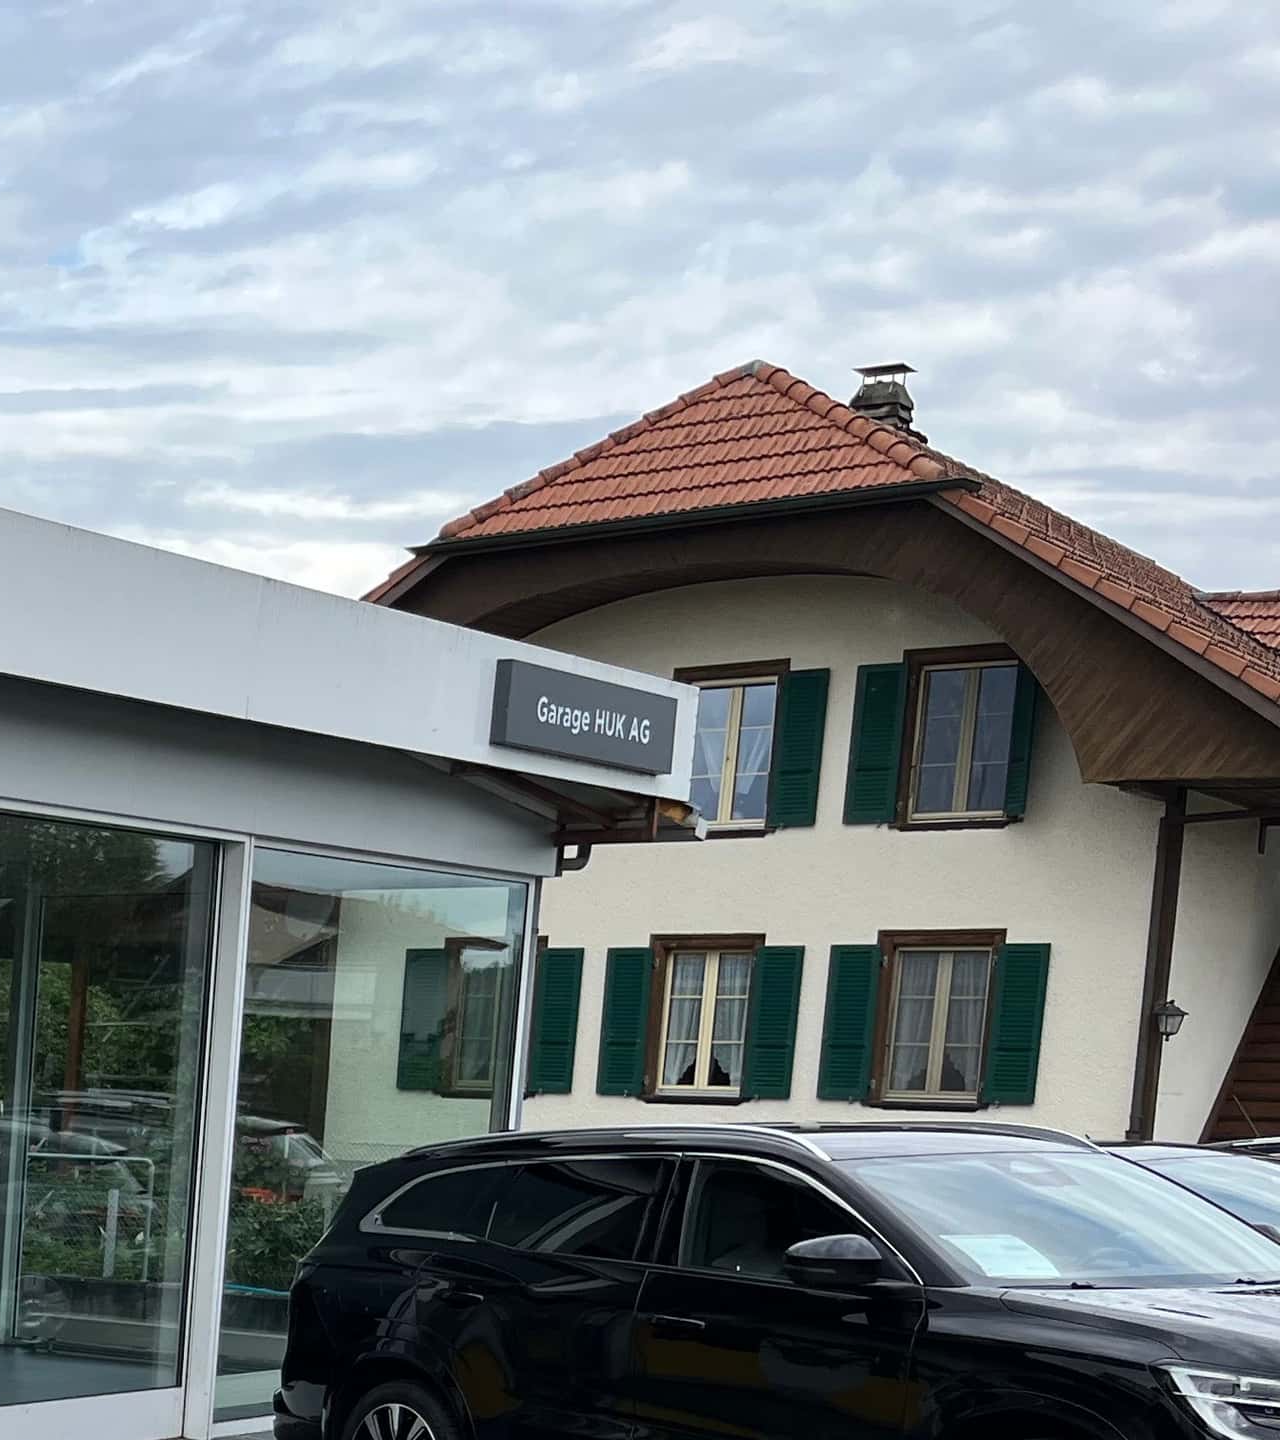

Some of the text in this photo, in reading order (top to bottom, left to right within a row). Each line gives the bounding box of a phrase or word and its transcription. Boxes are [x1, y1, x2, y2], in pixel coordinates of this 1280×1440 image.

[536, 696, 651, 744] Garage HUK AG
